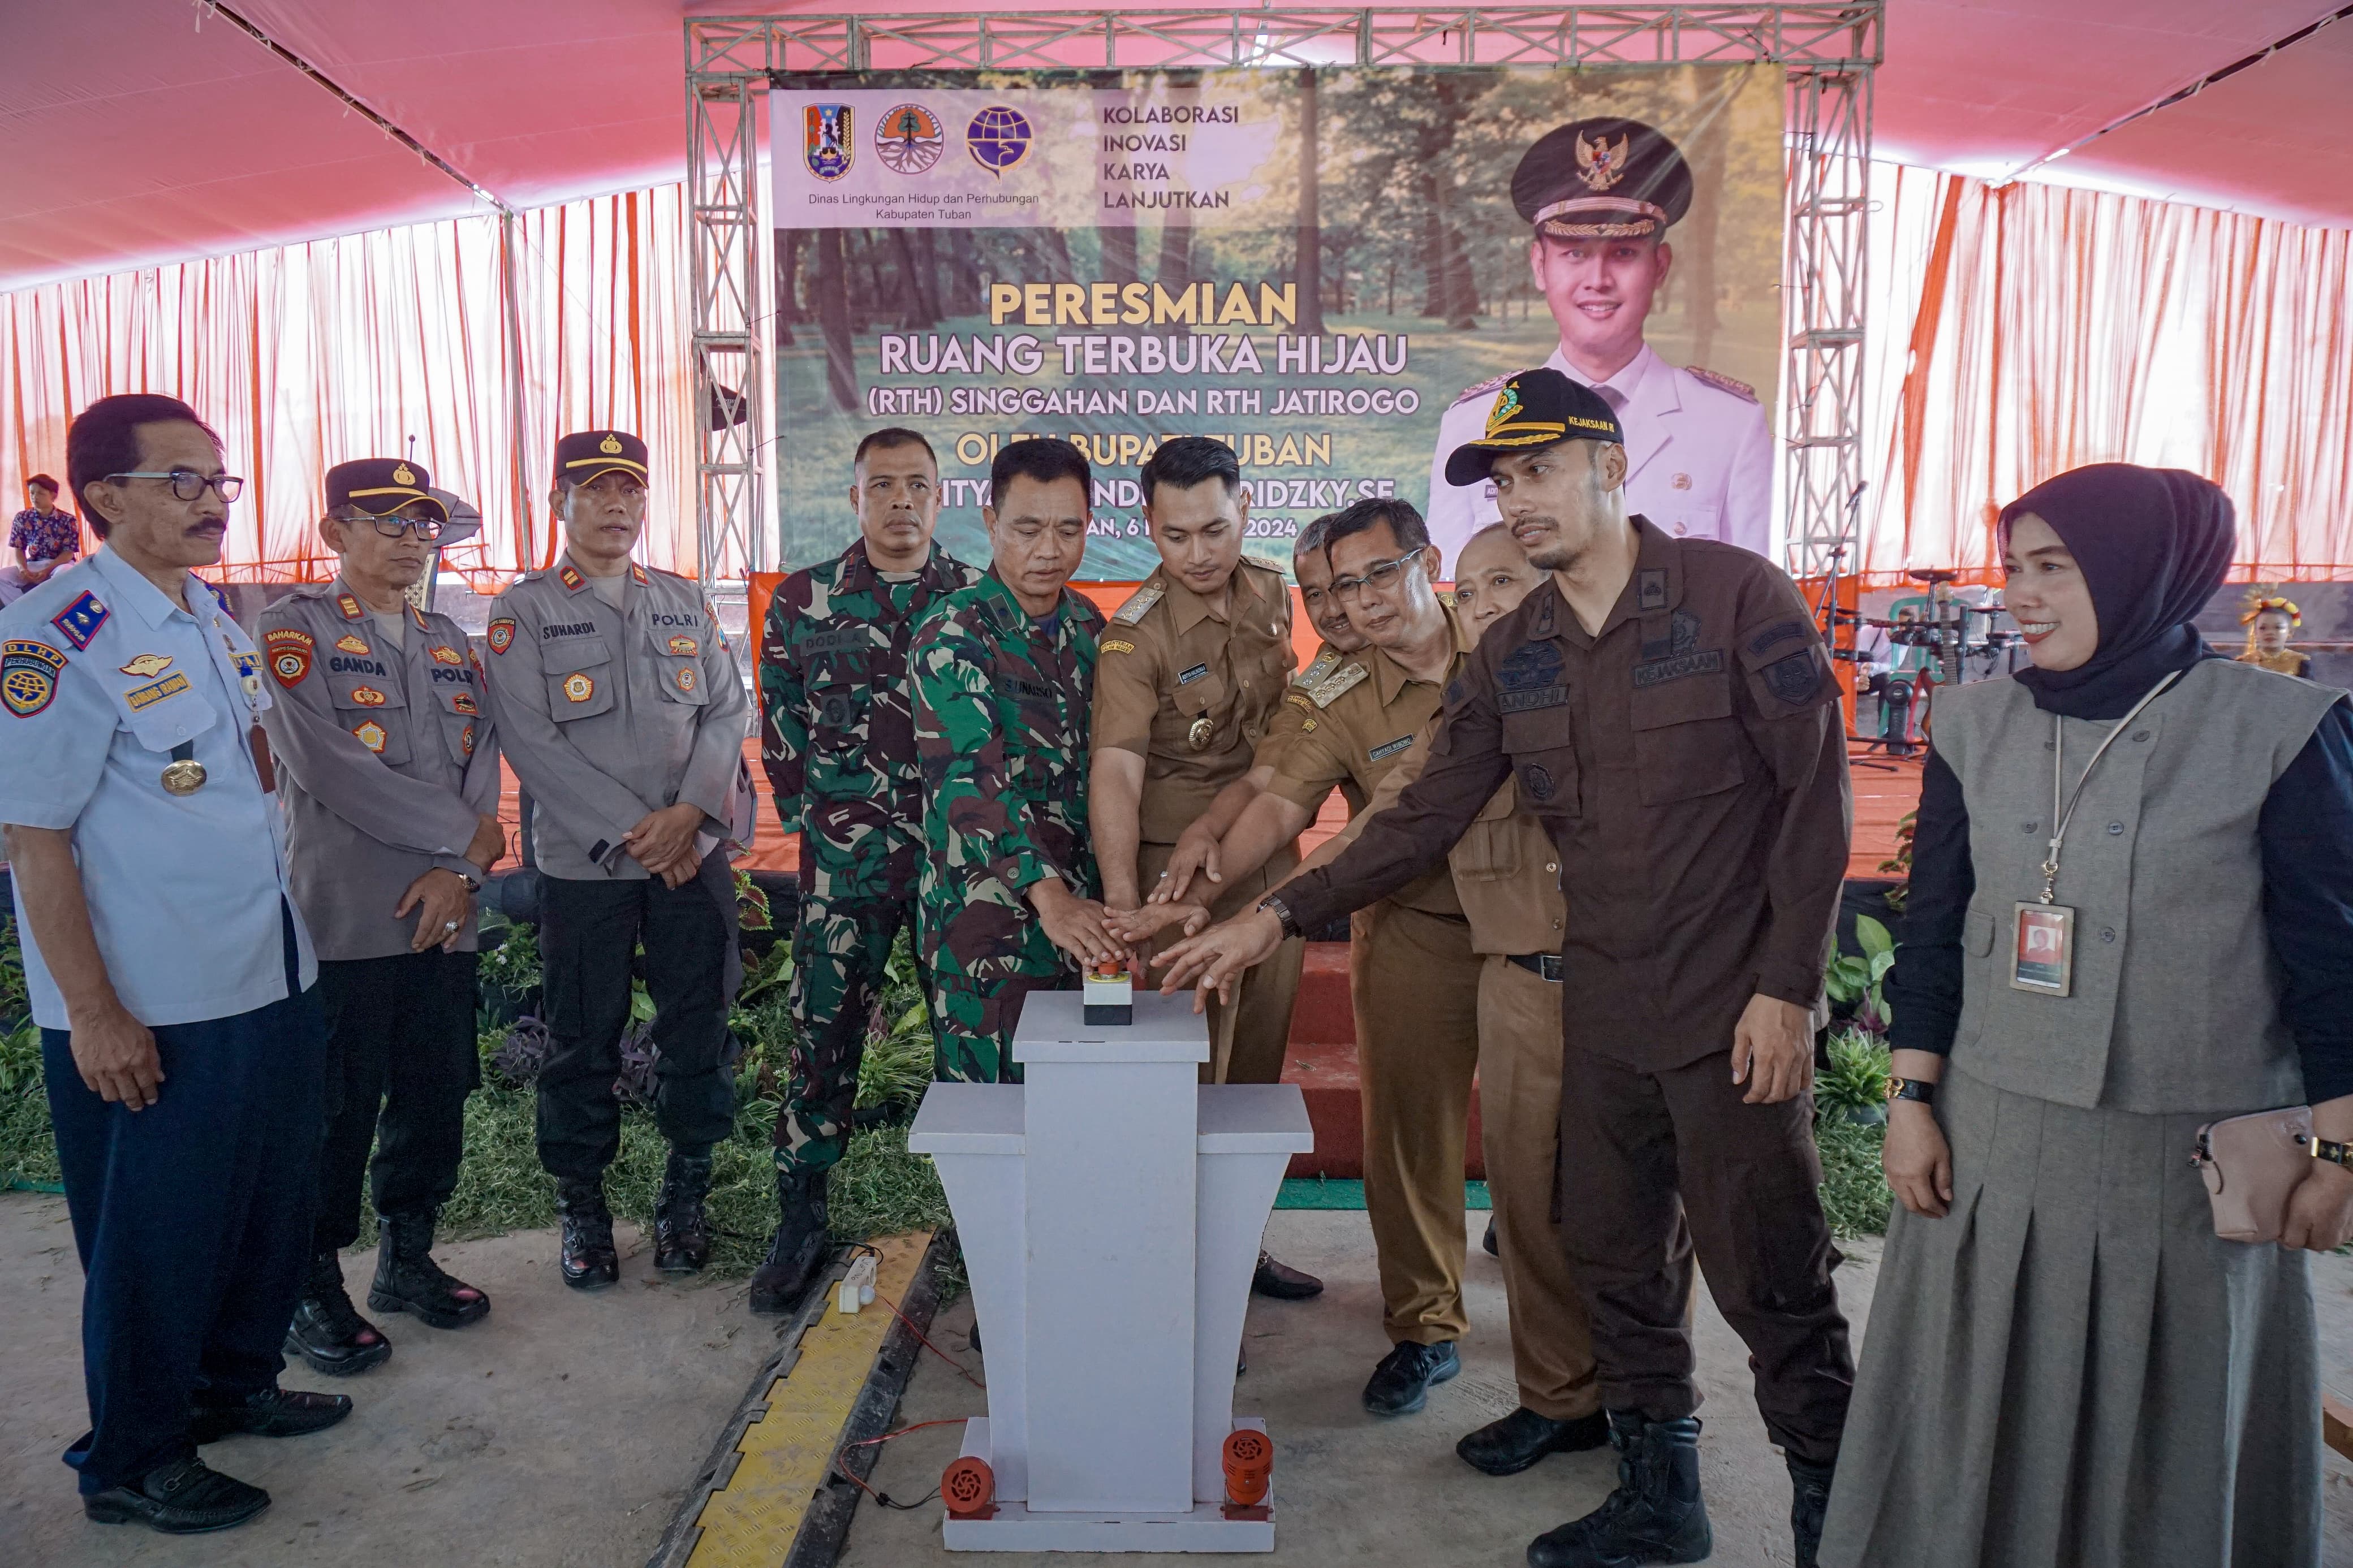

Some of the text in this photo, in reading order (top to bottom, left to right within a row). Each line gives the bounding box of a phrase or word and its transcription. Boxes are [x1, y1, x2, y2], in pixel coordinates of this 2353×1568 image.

[1104, 106, 1239, 124] KOLABORASI
[1104, 135, 1187, 152] INOVASI
[1104, 163, 1170, 180] KARYA
[809, 193, 1039, 207] Dinas Lingkungan Hidup dan Perhubungan
[1104, 191, 1229, 209] LANJUTKAN
[876, 209, 971, 221] Kabupaten Tuban
[991, 283, 1296, 325] PERESMIAN
[881, 335, 1407, 374] RUANG TERBUKA HIJAU
[869, 387, 1419, 416] (RTH) SINGGAHAN DAN RTH JATIROGO
[1568, 416, 1614, 433] KEJAKSAAN RI
[1127, 519, 1139, 535] 6
[1244, 519, 1297, 536] 2024
[652, 614, 698, 627] POLRI
[268, 630, 313, 646] BAHARKAM
[543, 621, 596, 640] SUHARDI
[8, 644, 60, 662] DLHP
[5, 657, 55, 677] PERHUBUNGAN
[330, 656, 386, 677] GANDA
[1372, 738, 1411, 757] CAHYADI WIBOWO
